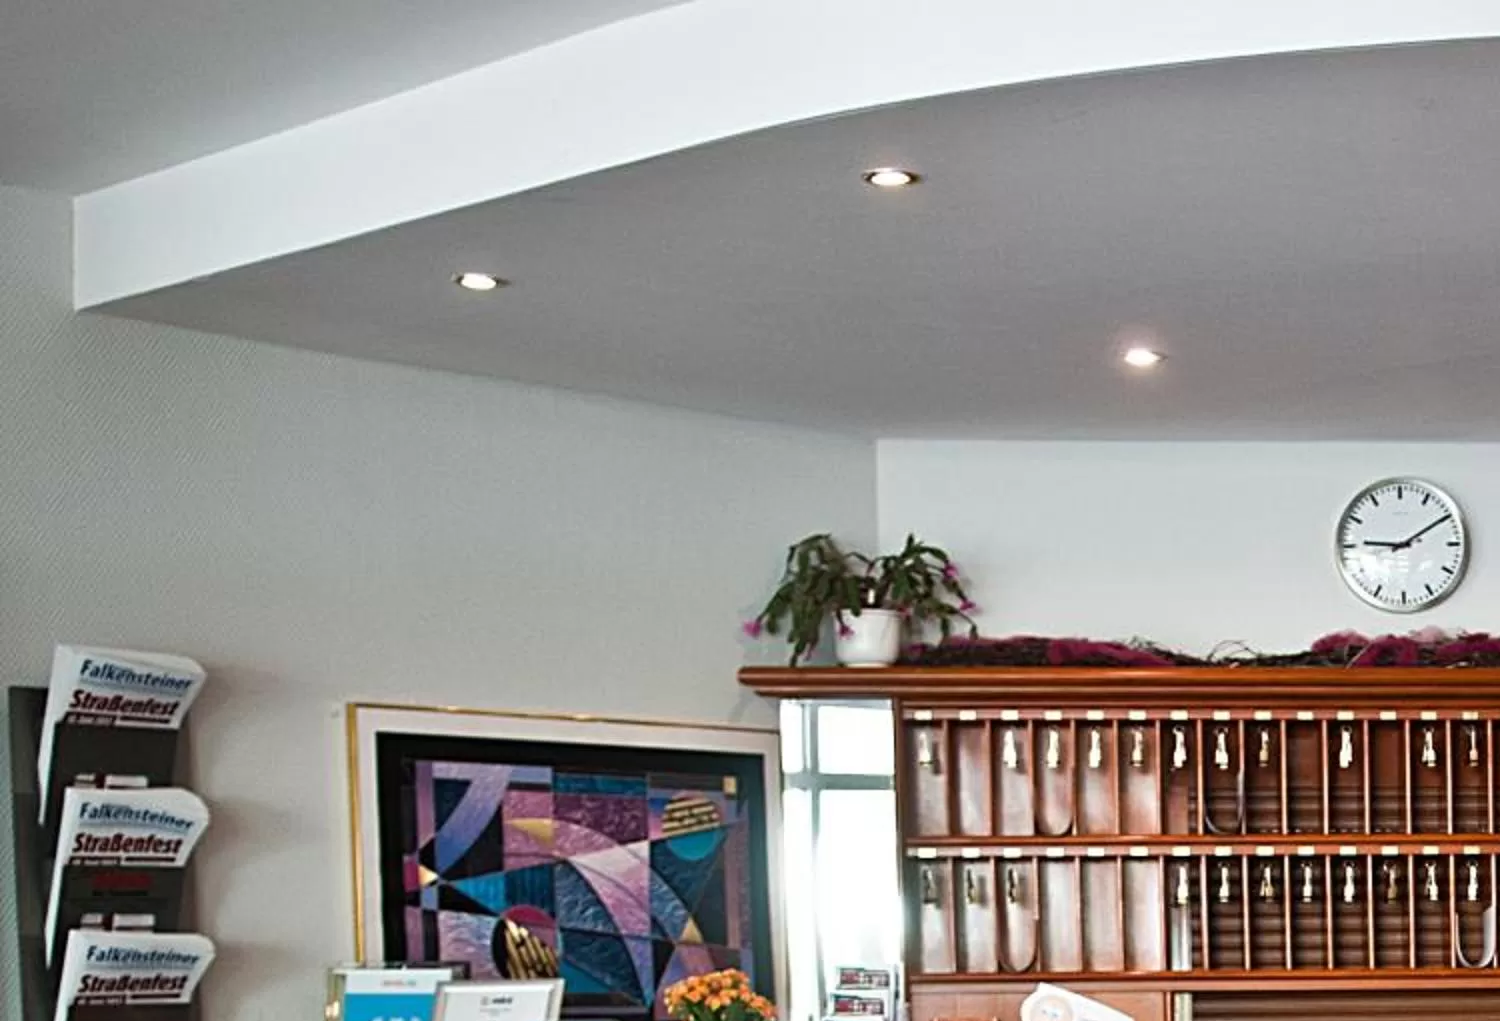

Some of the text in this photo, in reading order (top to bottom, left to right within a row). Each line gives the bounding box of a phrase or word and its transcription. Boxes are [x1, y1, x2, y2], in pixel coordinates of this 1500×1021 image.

[79, 659, 193, 690] Falkensteiner
[69, 689, 181, 715] Straßenfest
[79, 802, 195, 831] Falkensteiner
[71, 832, 184, 854] Straßenfest
[86, 945, 200, 966] Falkensteiner
[77, 973, 189, 993] Straßenfest
